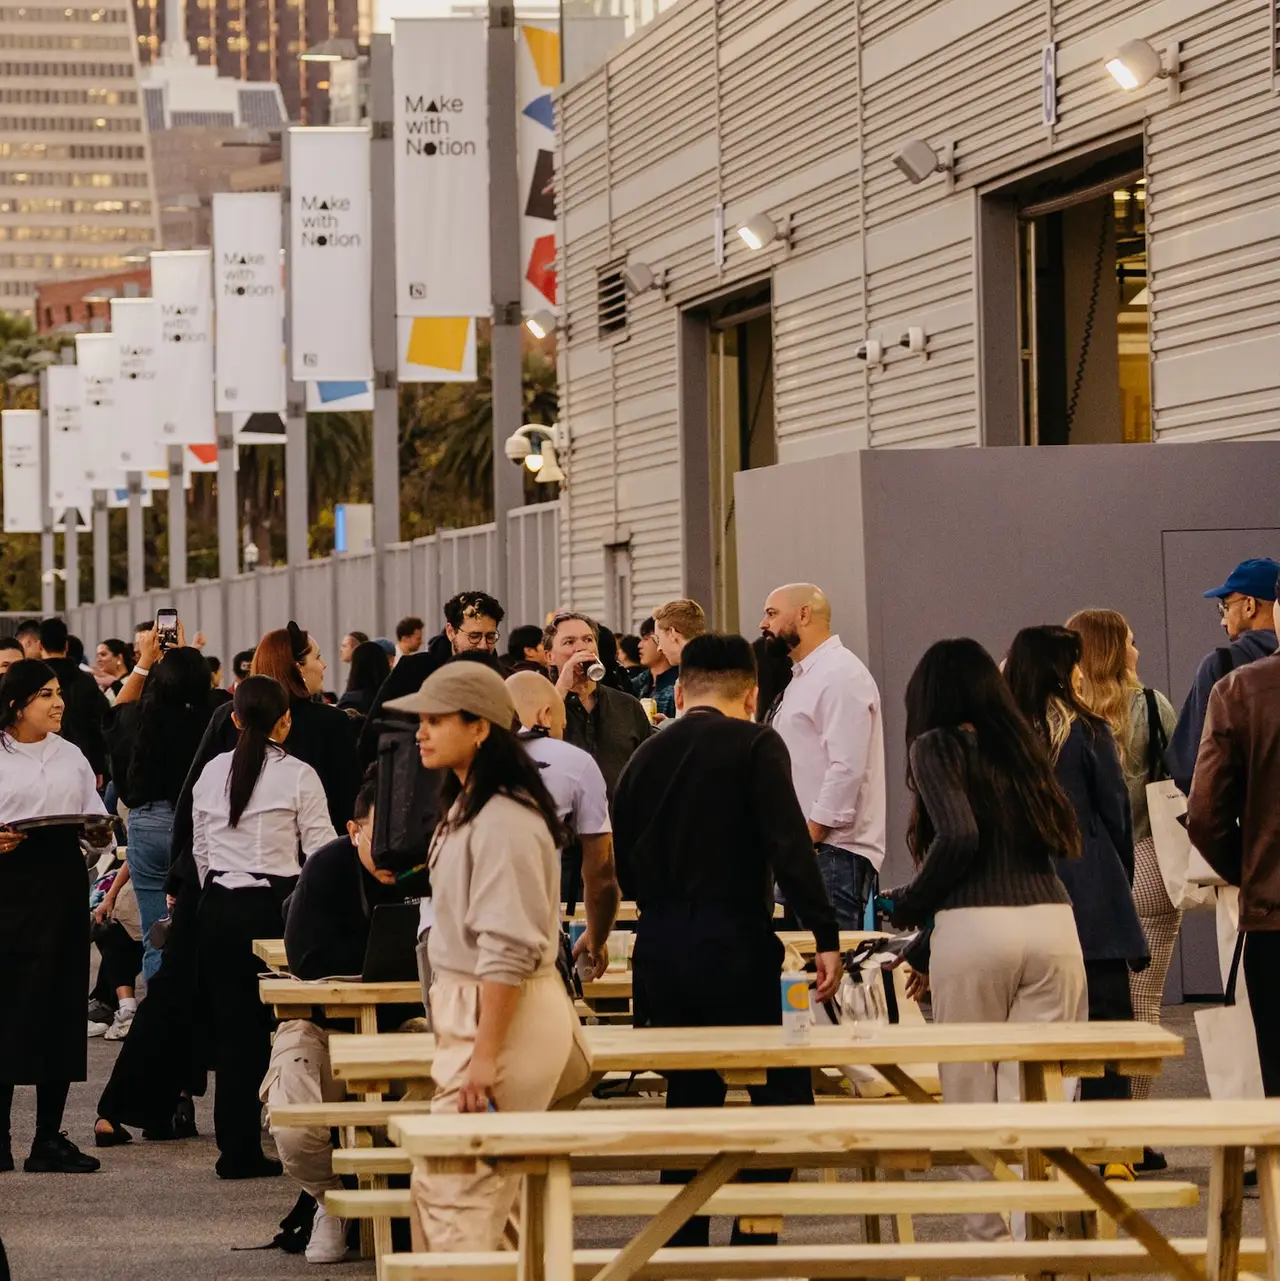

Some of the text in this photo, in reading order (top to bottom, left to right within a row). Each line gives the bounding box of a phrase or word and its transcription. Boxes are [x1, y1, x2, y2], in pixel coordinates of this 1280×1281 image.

[406, 116, 450, 135] with
[302, 213, 339, 229] with
[225, 267, 256, 281] with
